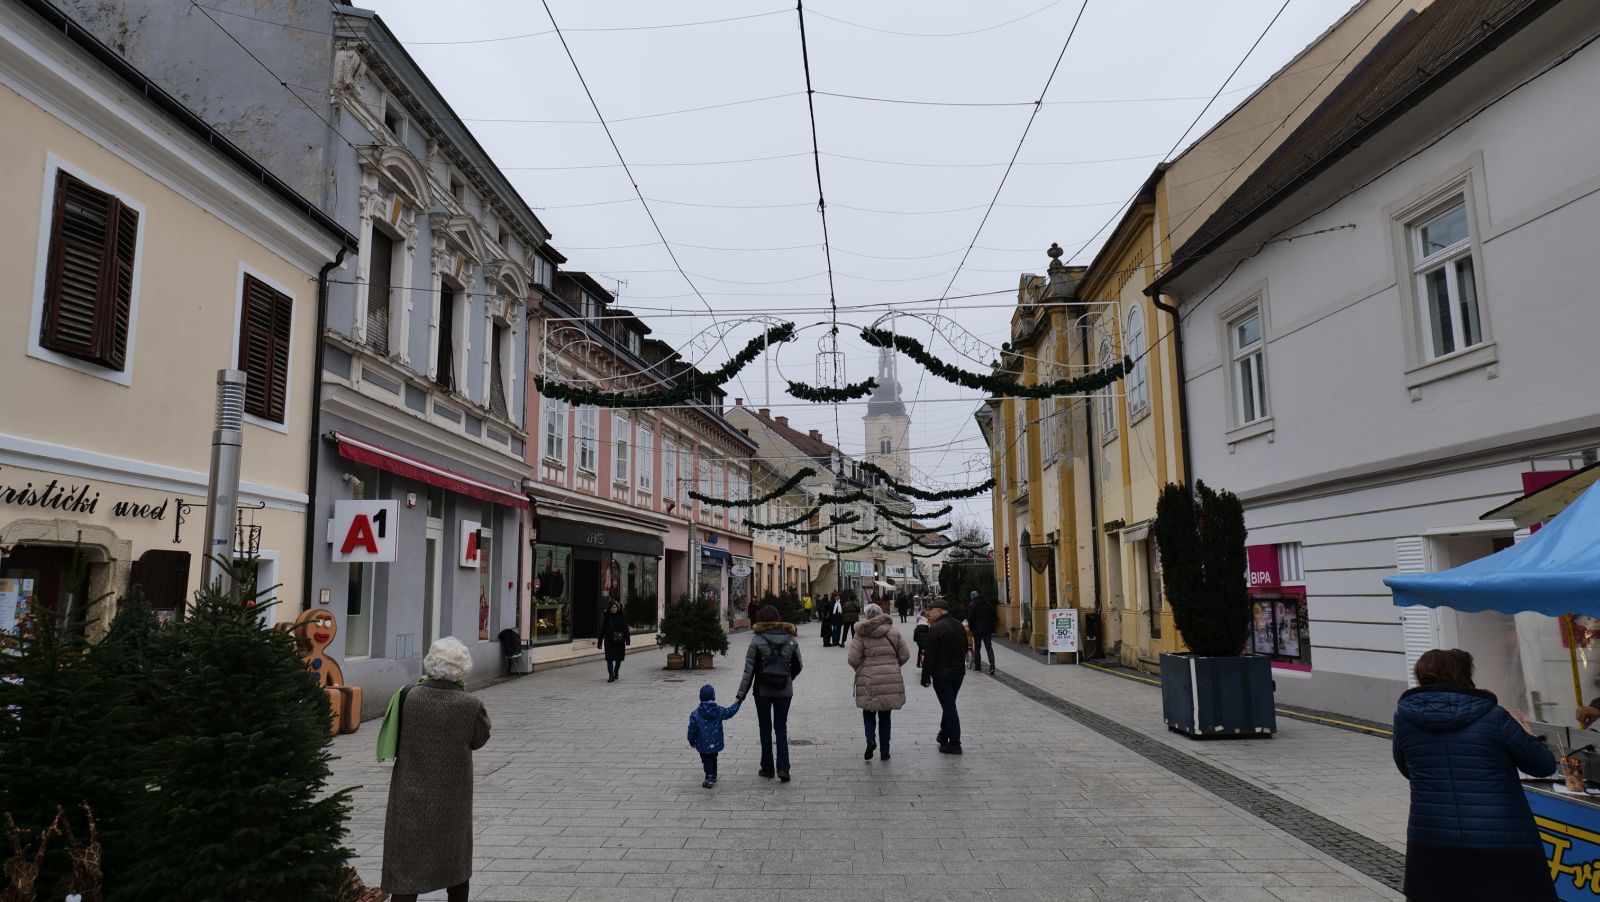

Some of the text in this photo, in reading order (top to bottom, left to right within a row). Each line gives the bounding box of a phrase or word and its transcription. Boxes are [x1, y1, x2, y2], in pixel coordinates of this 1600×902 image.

[0, 479, 168, 521] ristički ured
[340, 508, 388, 555] A1
[1250, 570, 1272, 585] BIPA
